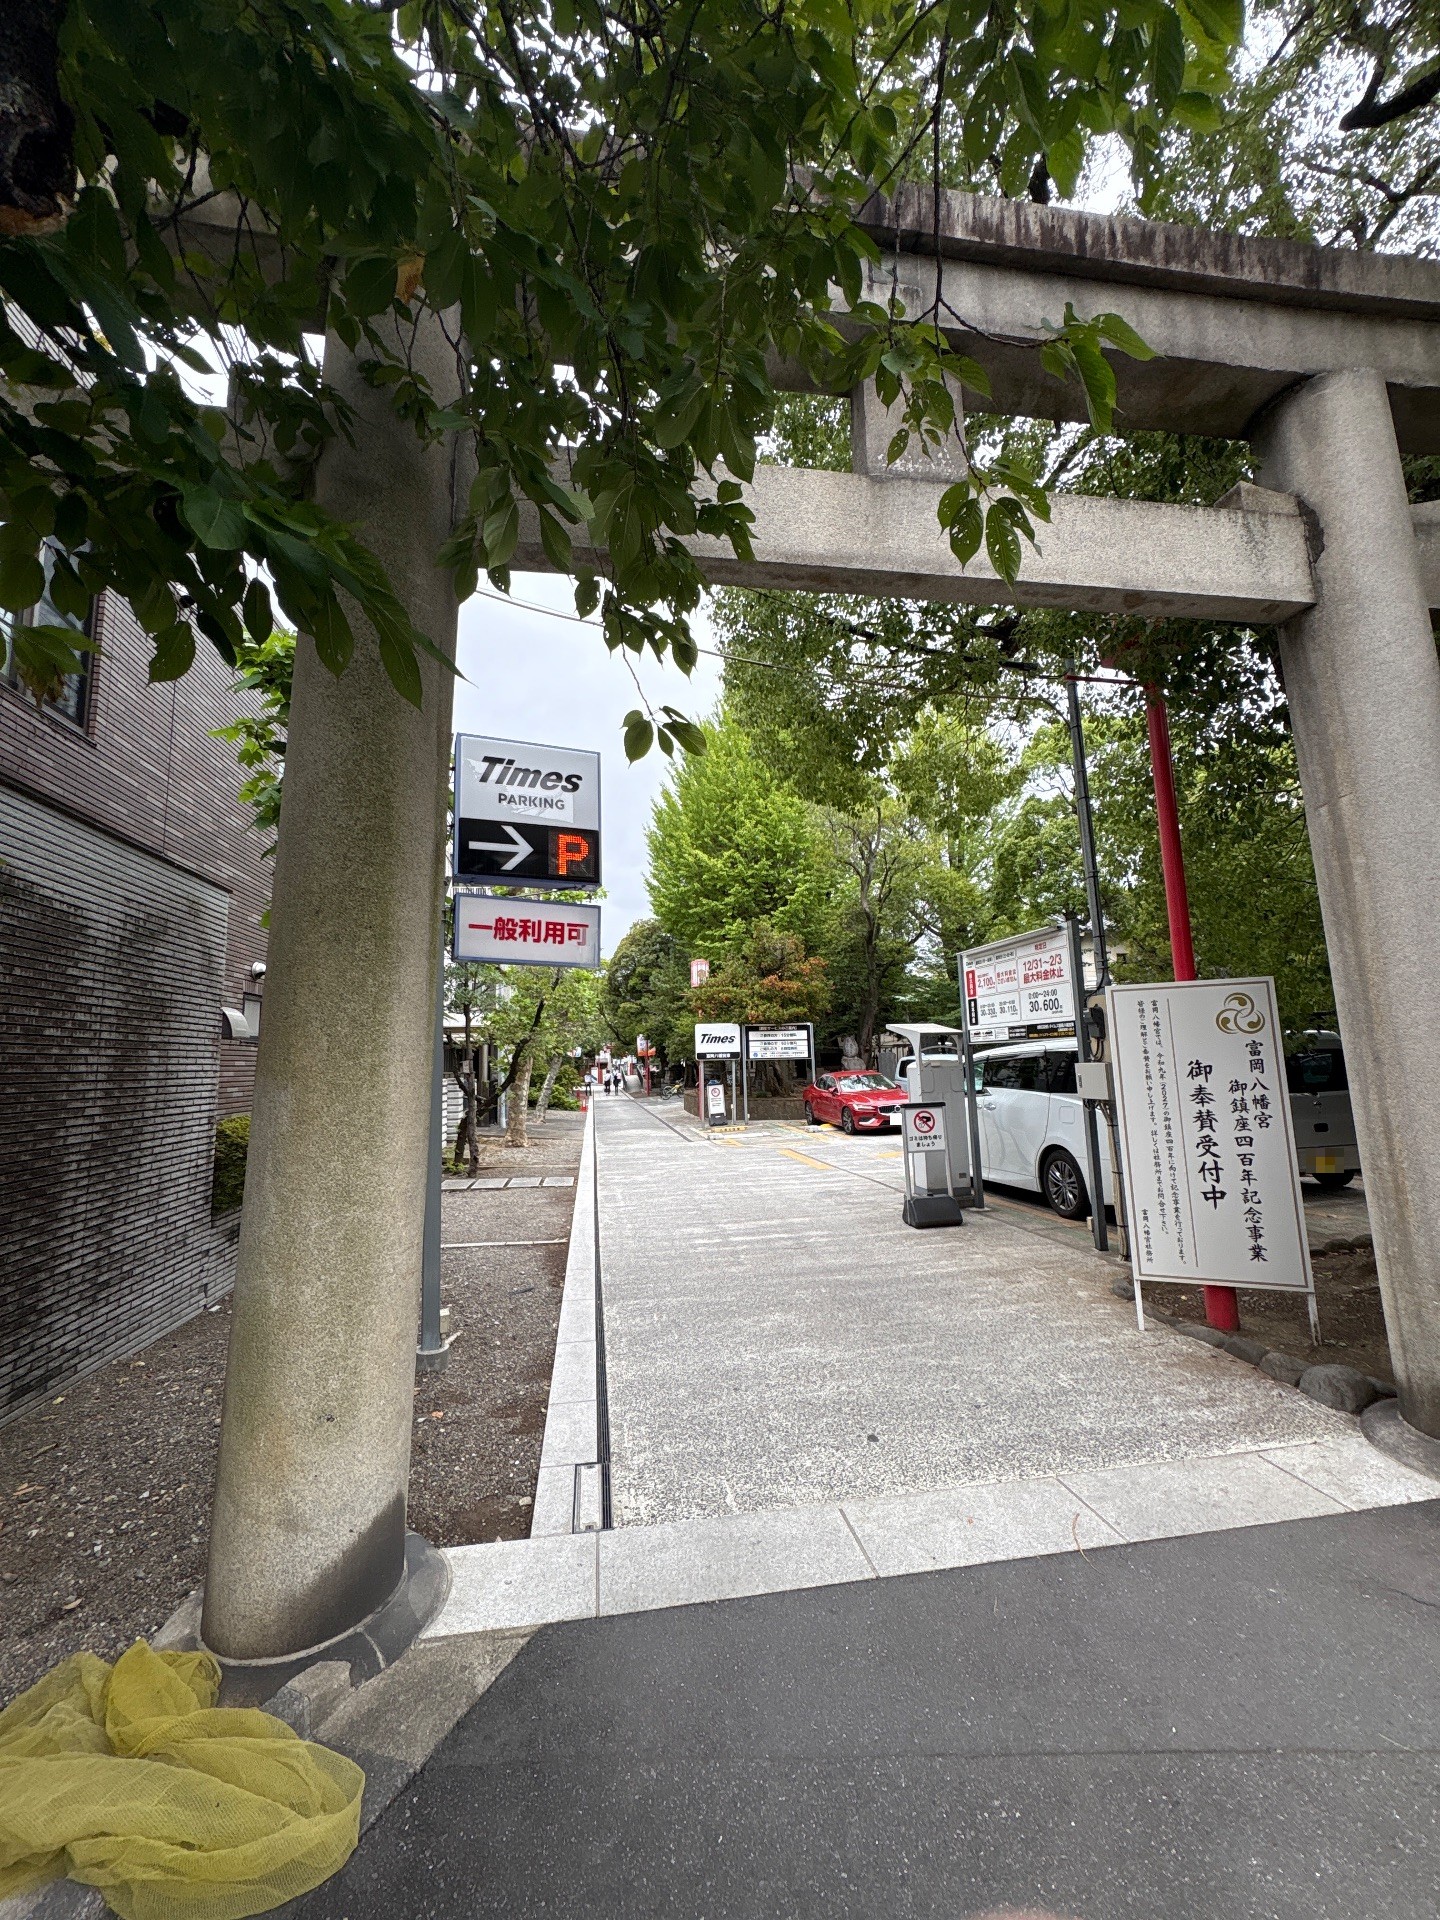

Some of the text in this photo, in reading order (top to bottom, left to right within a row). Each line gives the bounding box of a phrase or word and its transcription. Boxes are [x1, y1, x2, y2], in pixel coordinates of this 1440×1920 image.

[479, 755, 583, 793] Times
[498, 792, 565, 811] PARKING
[557, 833, 590, 875] P
[468, 916, 589, 947] 一般利用可
[1024, 966, 1064, 984] 最大料金休止
[700, 1033, 735, 1044] Times
[1245, 1040, 1273, 1130] 富岡八幡宮
[1186, 1059, 1228, 1211] 御奉賛受付中
[1228, 1079, 1269, 1263] 御鎮座四百年記念事業
